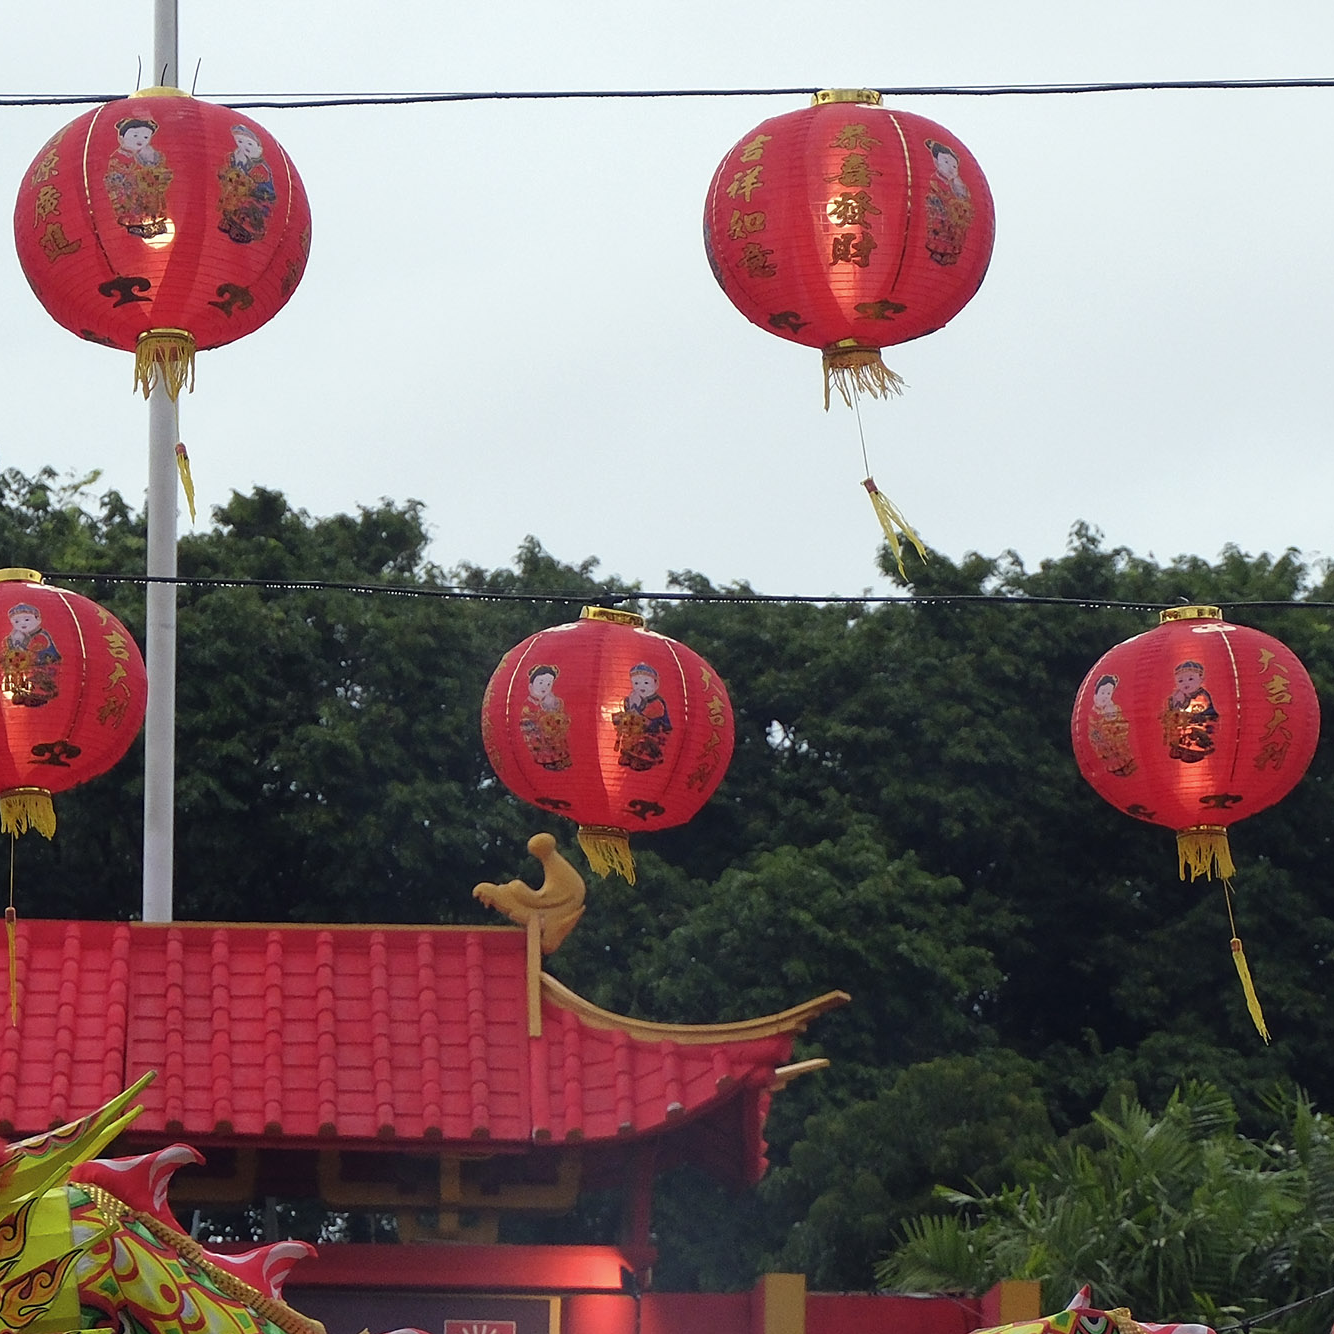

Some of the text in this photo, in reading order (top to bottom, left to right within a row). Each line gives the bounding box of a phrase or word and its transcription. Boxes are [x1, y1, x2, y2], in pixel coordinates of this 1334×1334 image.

[726, 135, 778, 278] 吉祥如意
[1254, 648, 1293, 771] 大吉大利
